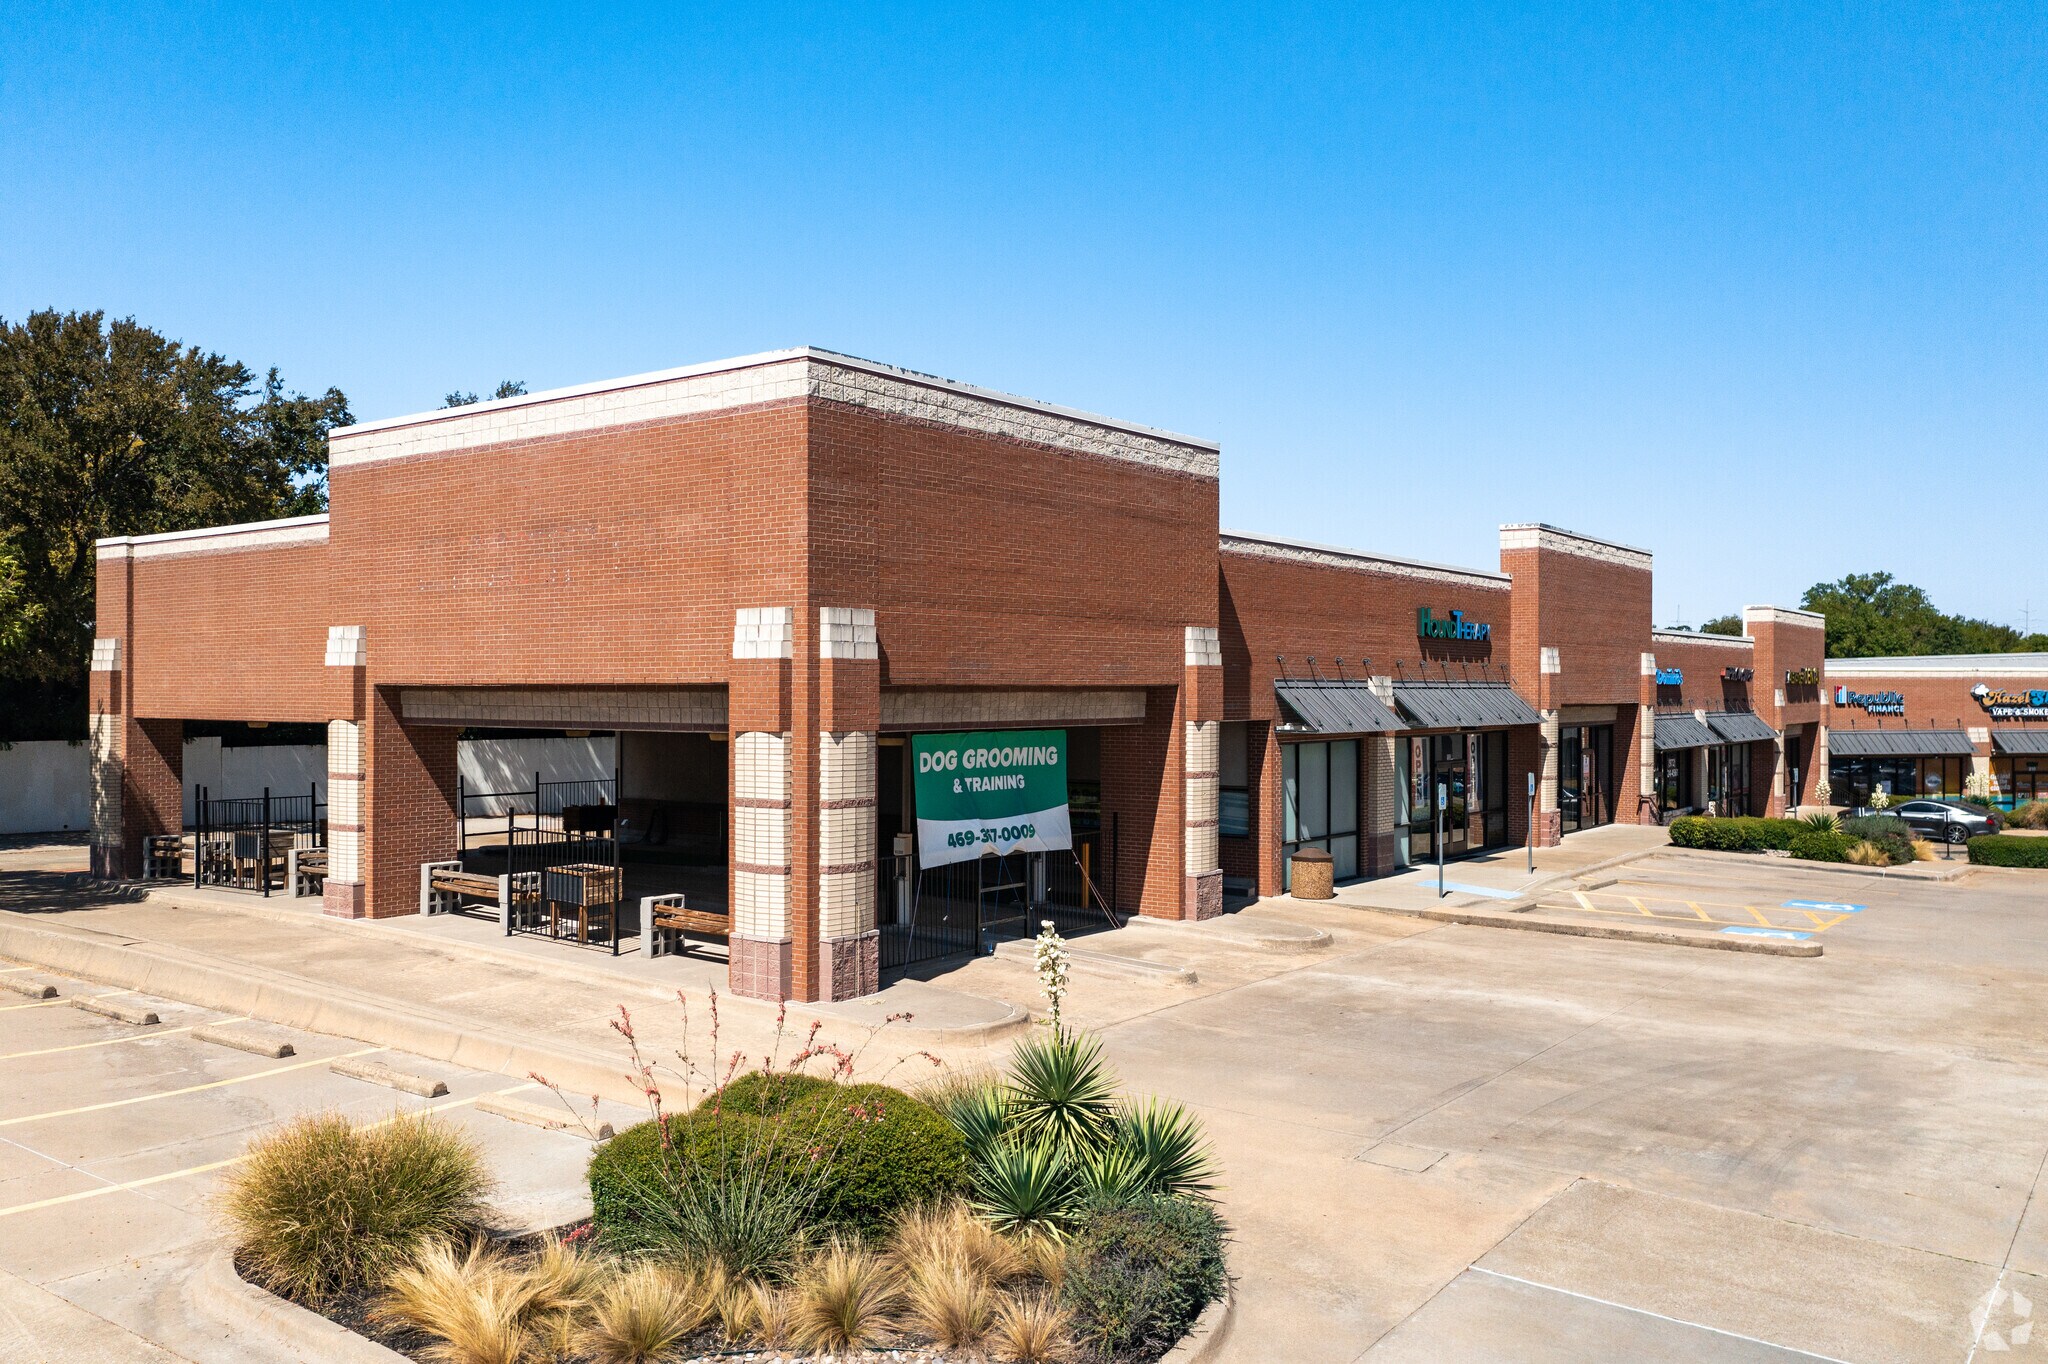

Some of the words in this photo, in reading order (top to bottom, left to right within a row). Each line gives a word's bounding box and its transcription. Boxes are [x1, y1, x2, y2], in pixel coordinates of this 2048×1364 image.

[1847, 691, 1904, 706] Republic
[1983, 689, 2030, 706] Hazel
[1868, 704, 1904, 713] FINANCE
[1992, 708, 2013, 716] VAPE
[2015, 708, 2021, 716] &
[2023, 708, 2048, 716] SMOKE
[919, 750, 958, 773] DOG
[962, 746, 1058, 769] GROOMING
[953, 778, 963, 793] &
[964, 774, 1025, 792] TRAINING
